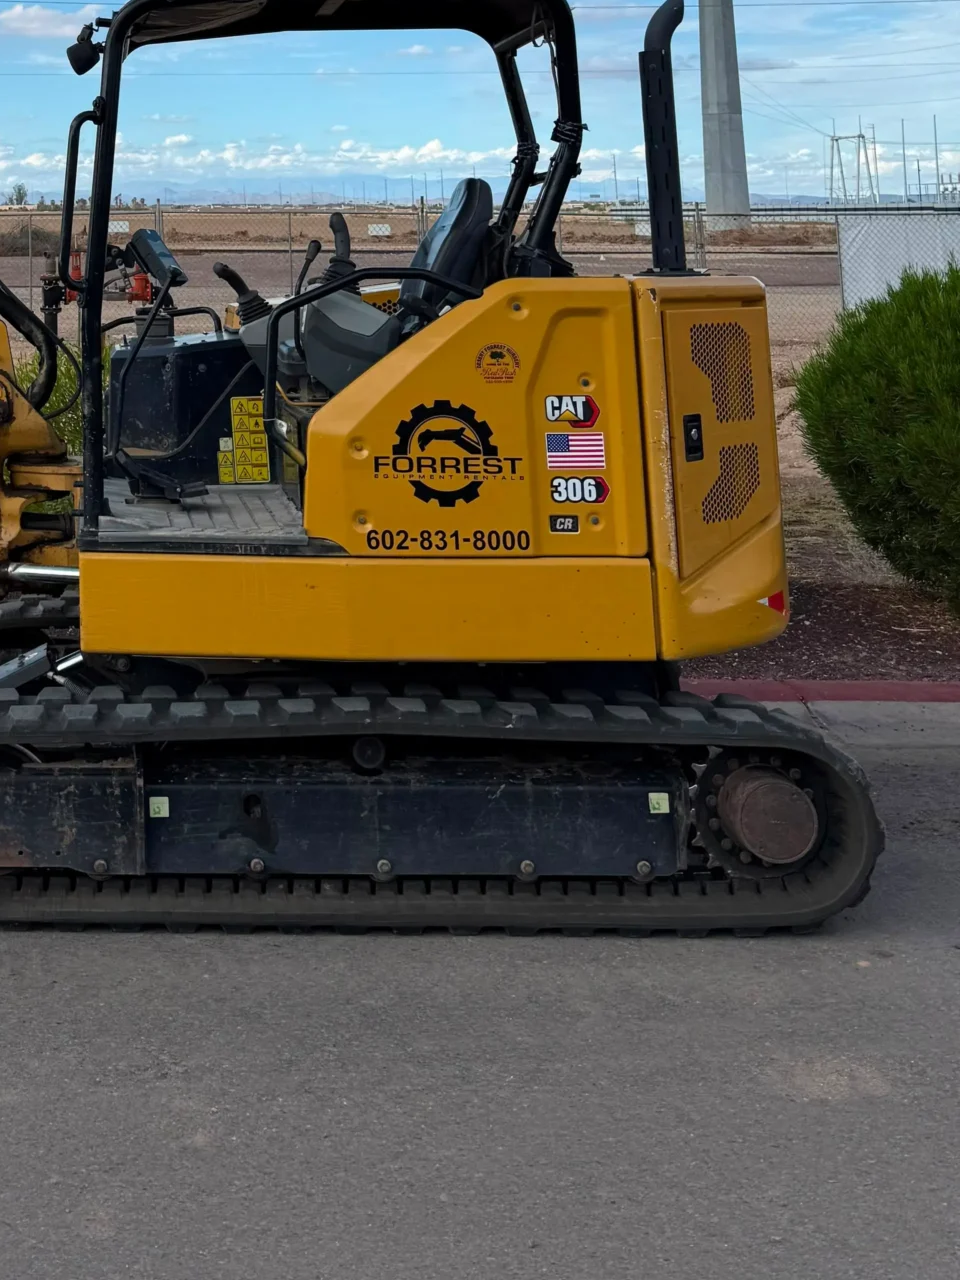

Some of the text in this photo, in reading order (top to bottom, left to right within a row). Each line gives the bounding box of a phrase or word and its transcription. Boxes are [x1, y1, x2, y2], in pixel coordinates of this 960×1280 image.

[545, 395, 586, 421] CAT
[373, 456, 523, 474] FORREST
[552, 478, 597, 501] 306
[556, 518, 573, 530] CR
[366, 529, 531, 551] 602-831-8000
